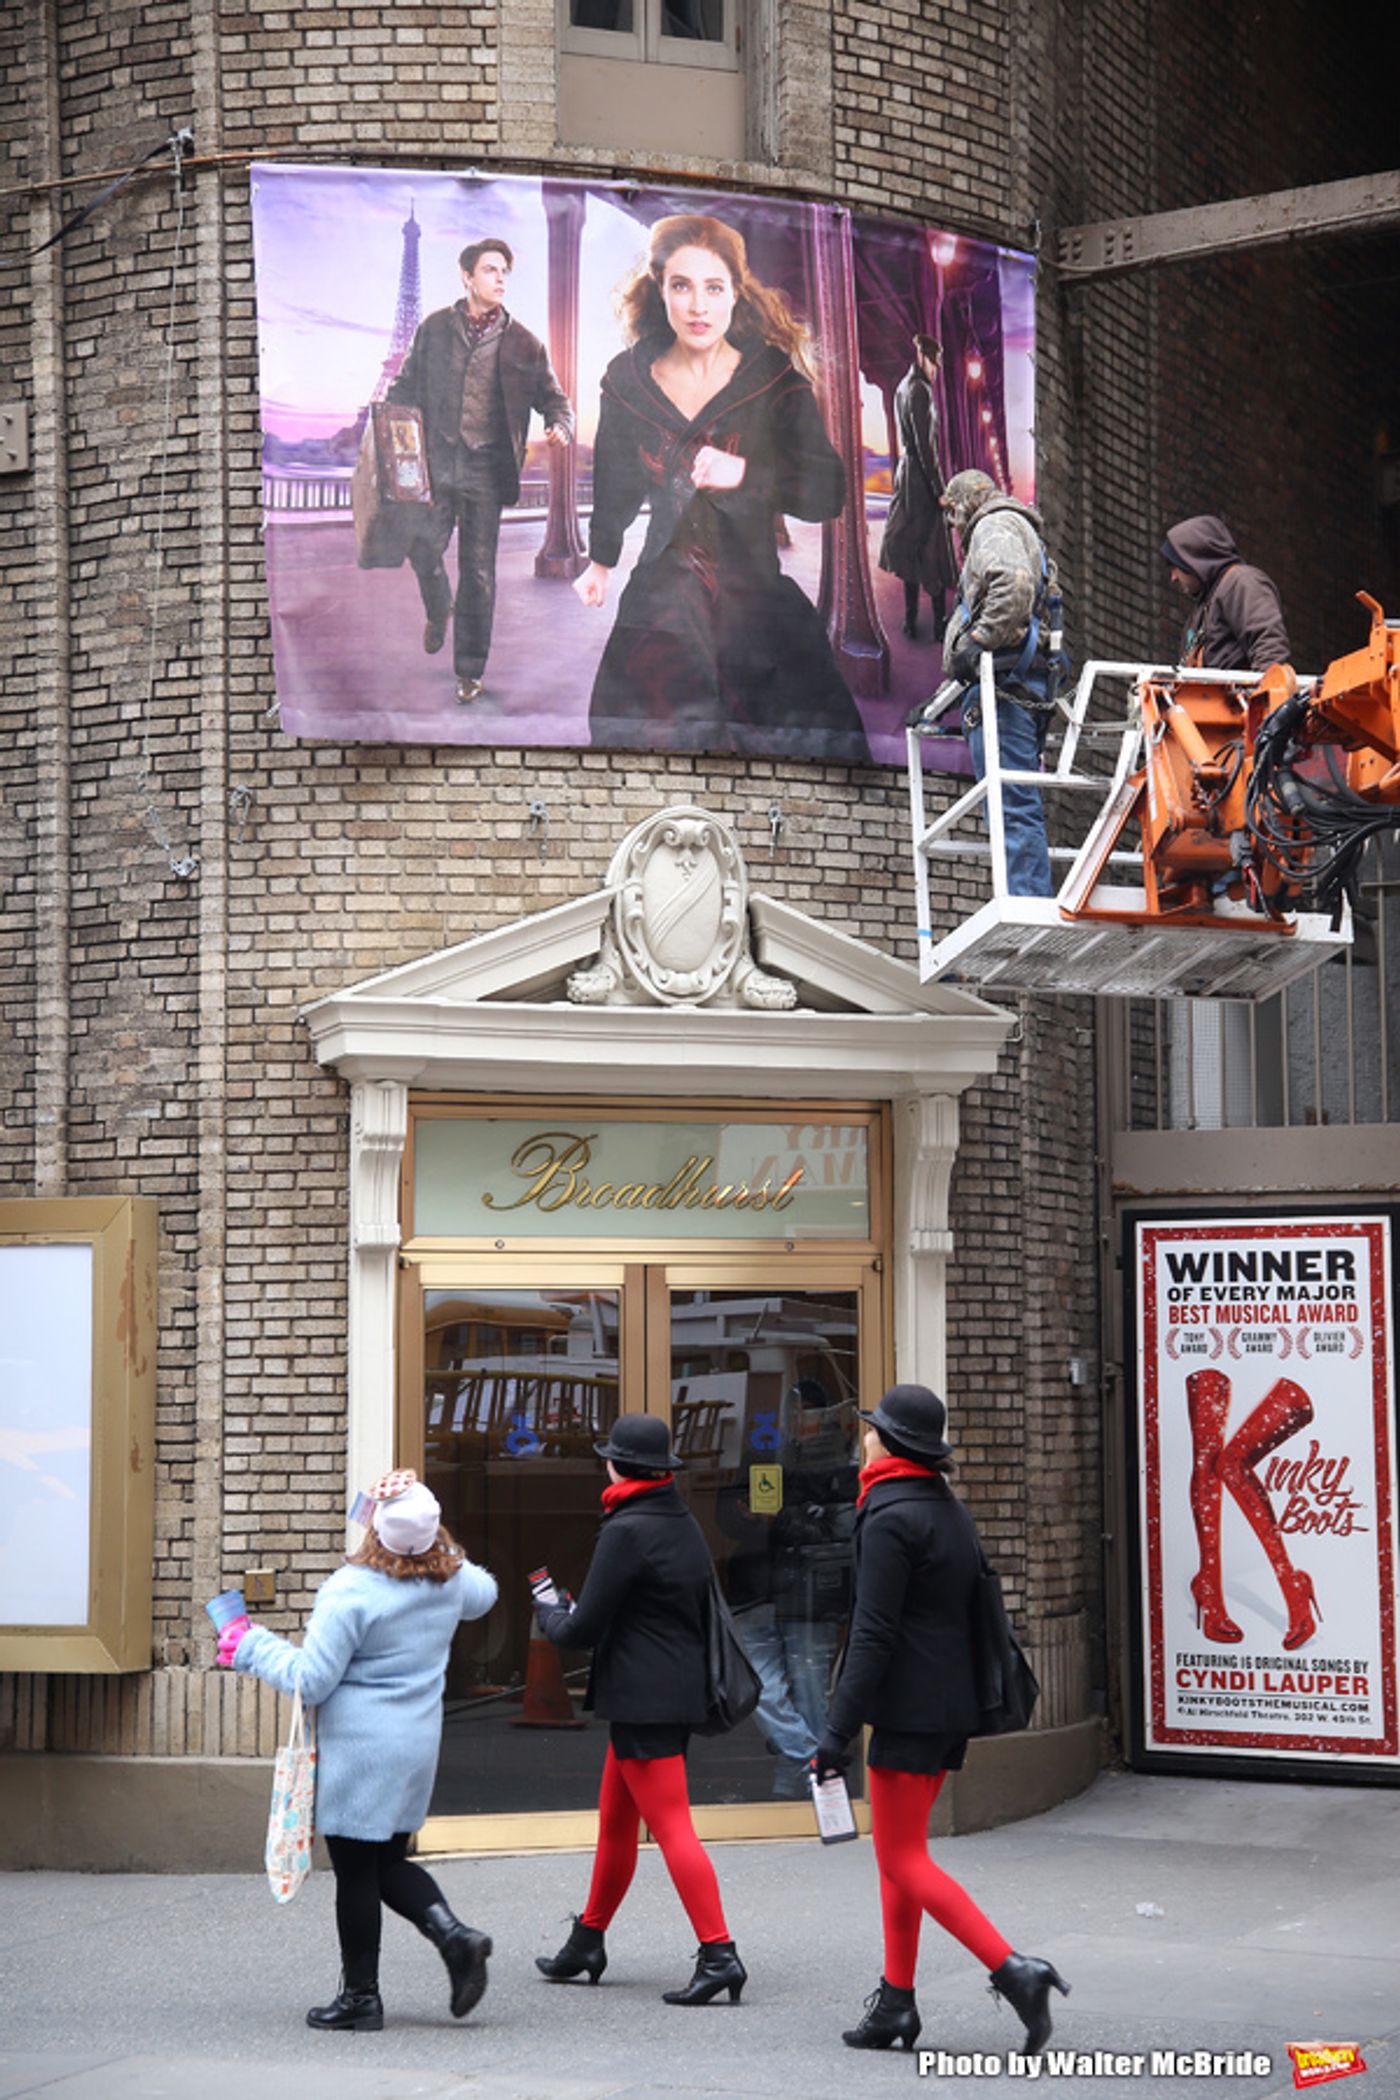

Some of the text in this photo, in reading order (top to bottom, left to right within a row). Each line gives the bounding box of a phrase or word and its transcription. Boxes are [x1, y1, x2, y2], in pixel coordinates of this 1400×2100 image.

[481, 1131, 803, 1212] Broadhurst
[1165, 1250, 1356, 1284] WINNER
[1167, 1285, 1356, 1303] OF EVERY MAJOR
[1168, 1303, 1359, 1325] BEST MUSICAL AWARD
[1241, 1332, 1278, 1343] GRAMMY
[1313, 1331, 1346, 1343] OLIVIER
[1180, 1343, 1208, 1354] AWARD
[1245, 1343, 1274, 1354] AWARD
[1315, 1342, 1345, 1353] AWARD
[1276, 1494, 1369, 1537] Boots
[1176, 1652, 1238, 1669] FEATURING
[1256, 1656, 1309, 1672] ORIGINAL
[1311, 1658, 1352, 1673] SONGS
[1353, 1660, 1369, 1674] BY
[1176, 1668, 1369, 1696] CYNDI LAUPER
[1178, 1695, 1369, 1712] KINKYBOOTSTHEMUSICAL.COM
